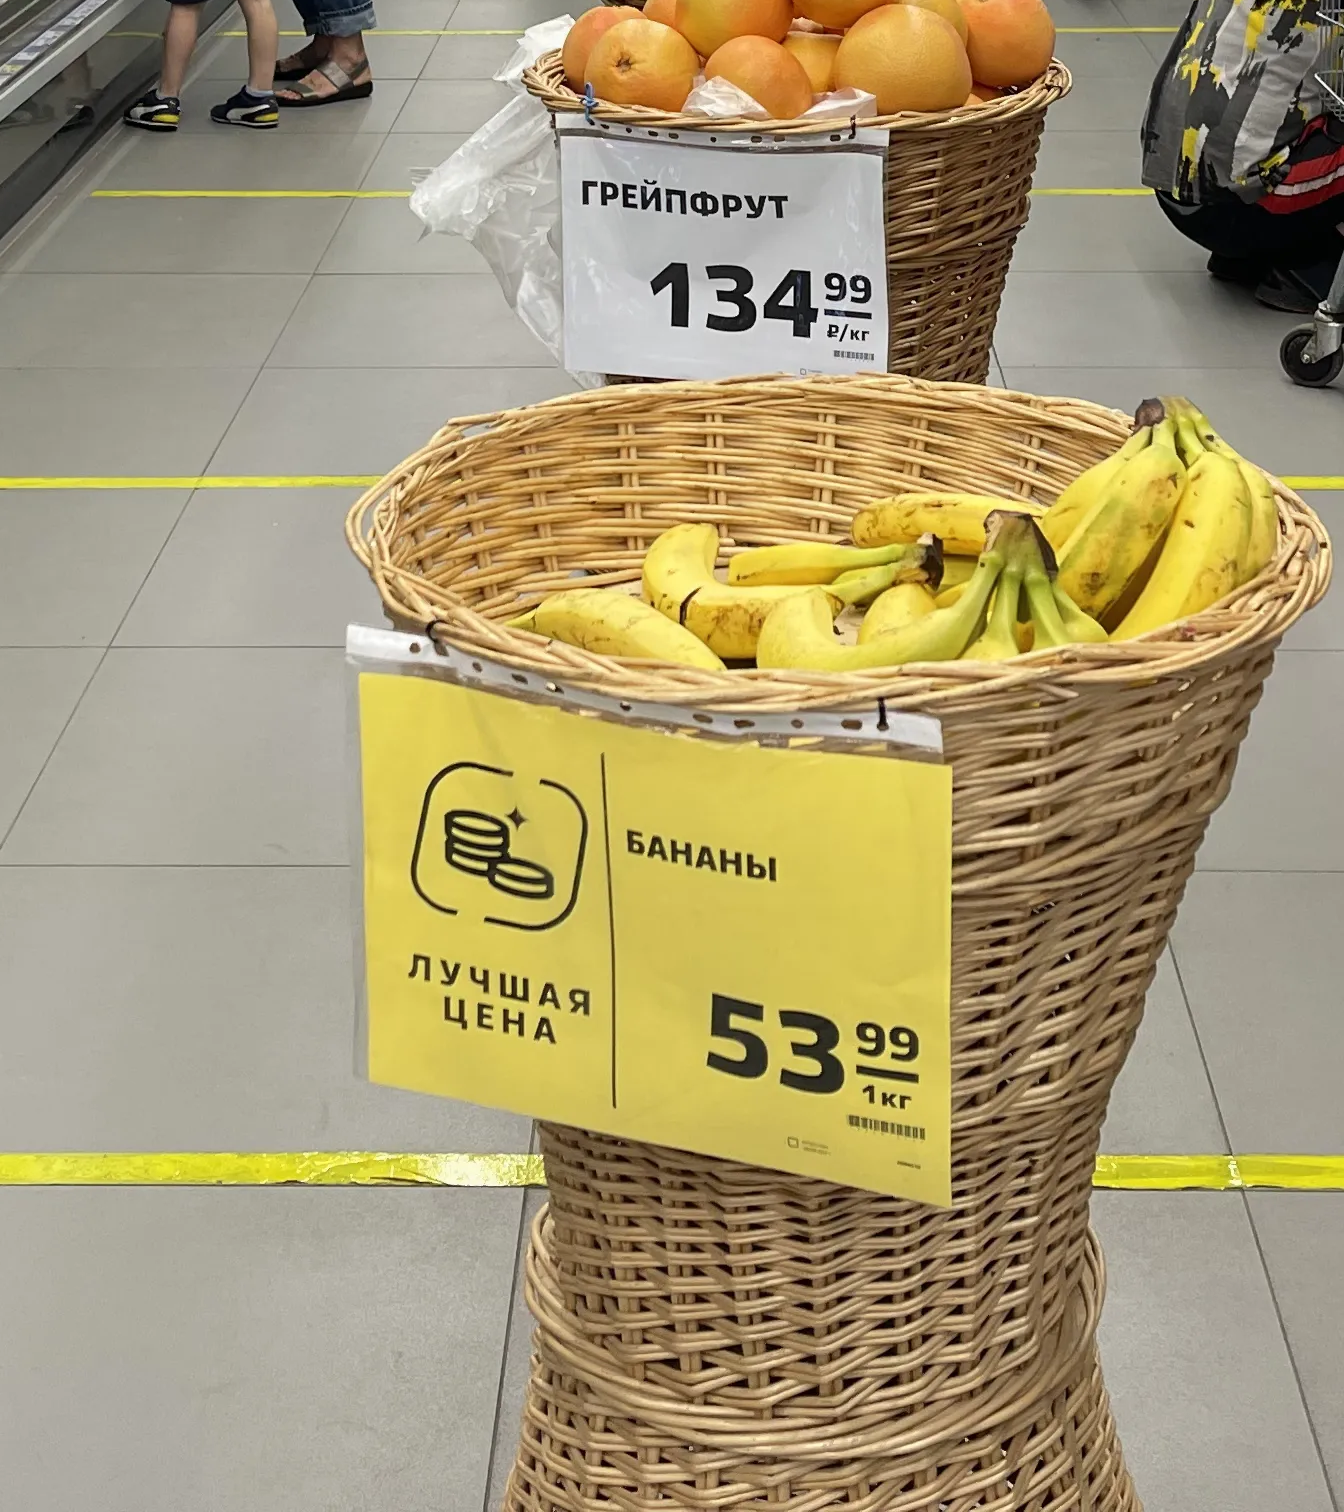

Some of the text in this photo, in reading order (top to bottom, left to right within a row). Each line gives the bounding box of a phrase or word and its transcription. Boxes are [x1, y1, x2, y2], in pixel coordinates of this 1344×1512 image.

[581, 179, 789, 219] ГРЕЙПФРУТ
[650, 262, 872, 339] 134 99
[827, 324, 870, 343] ₽/кг
[626, 828, 777, 882] БАНАНЫ
[407, 953, 592, 1016] ЛУЧШАЯ
[443, 996, 557, 1045] ЦЕНА
[706, 993, 919, 1095] 53 99
